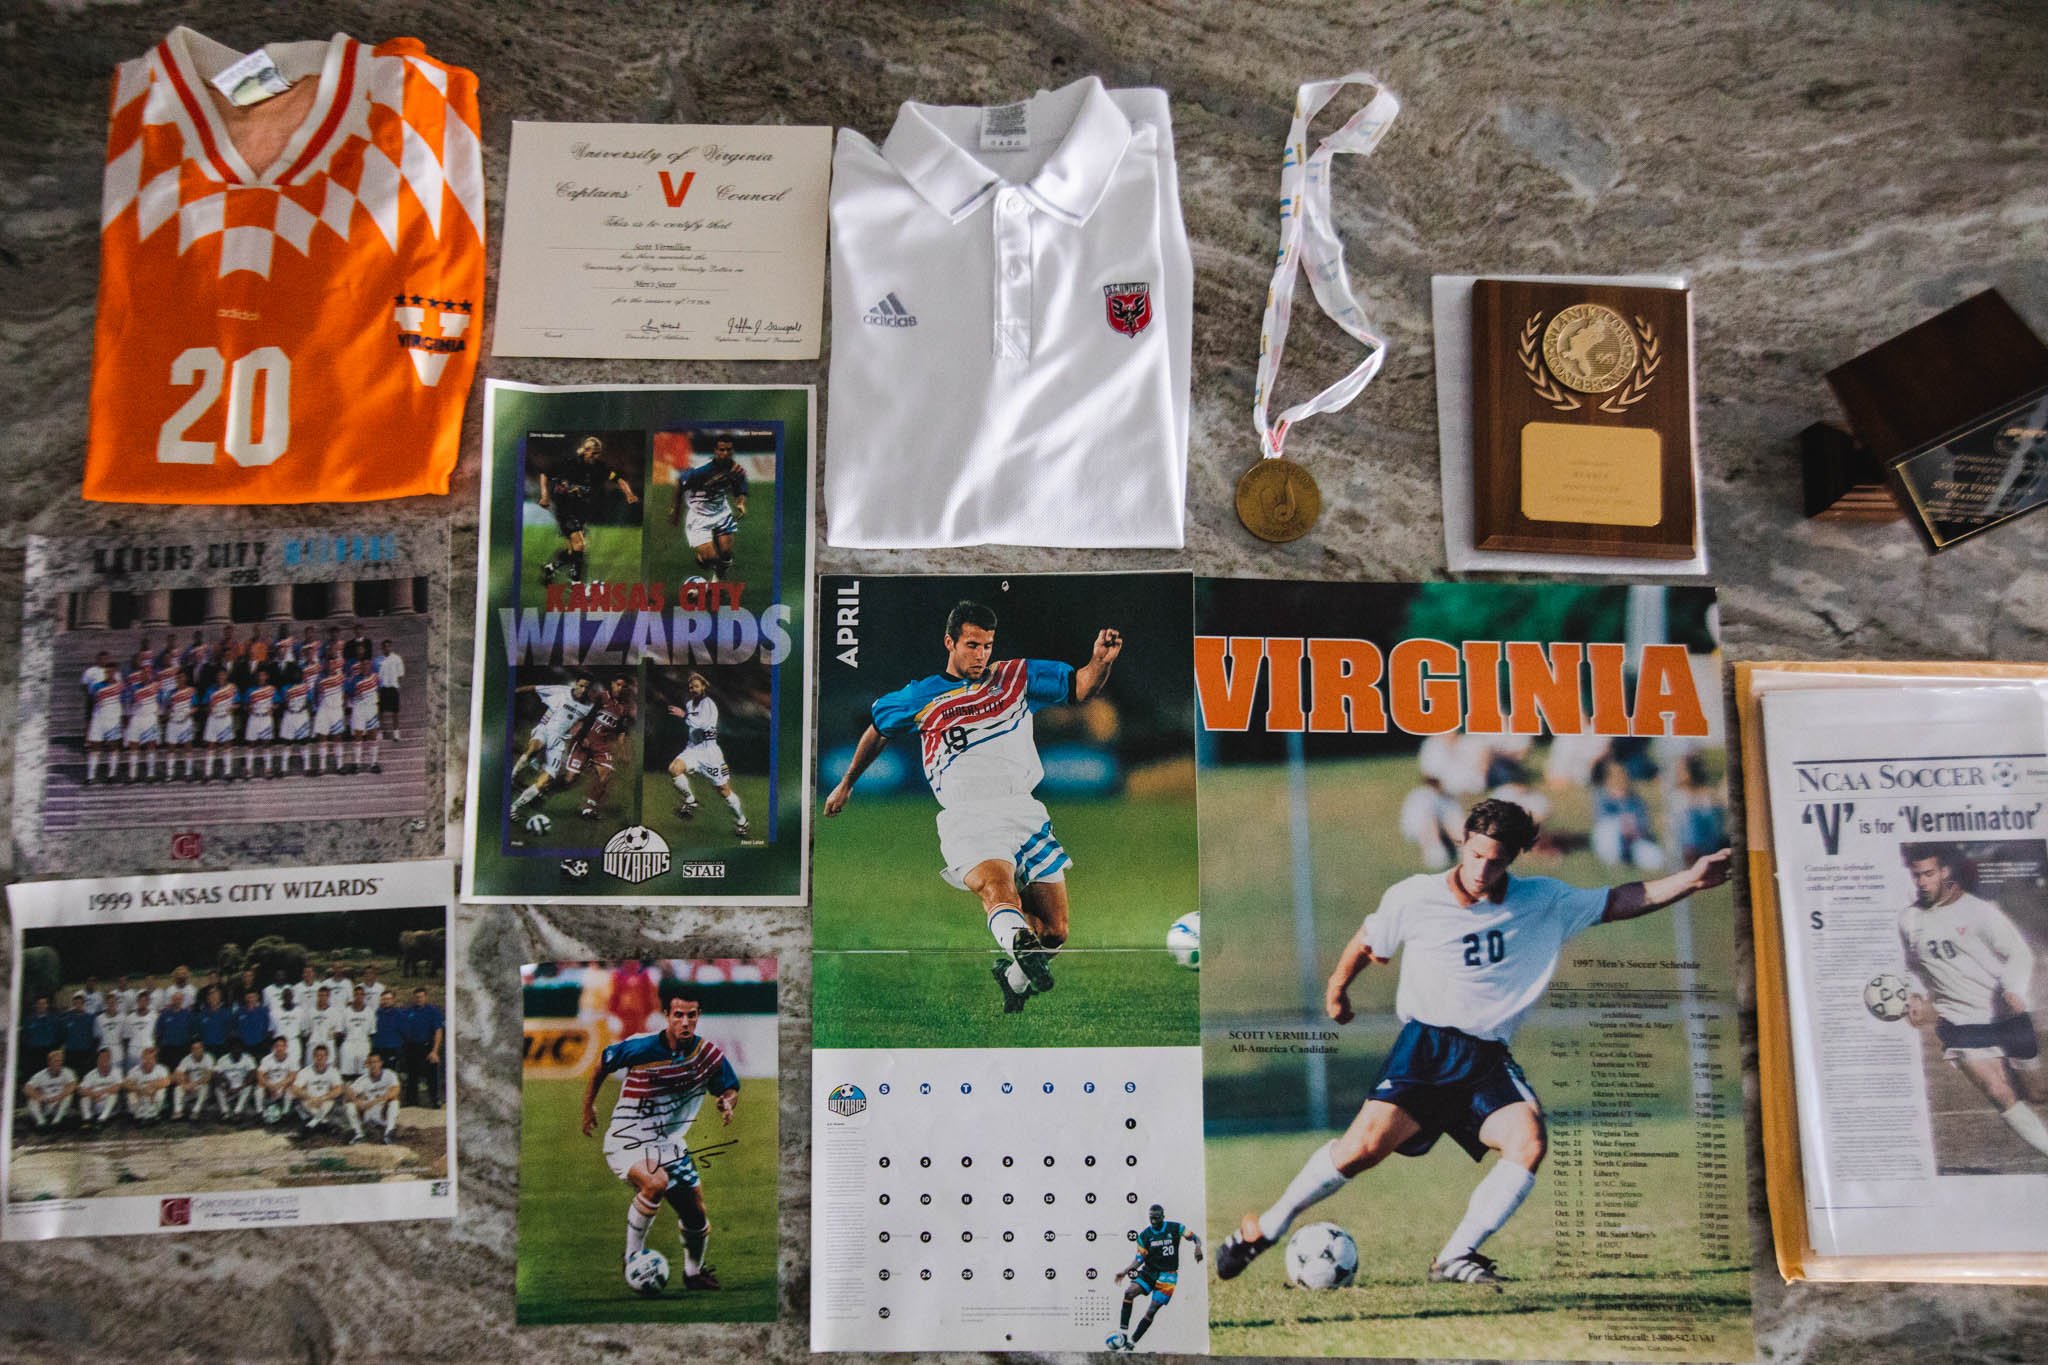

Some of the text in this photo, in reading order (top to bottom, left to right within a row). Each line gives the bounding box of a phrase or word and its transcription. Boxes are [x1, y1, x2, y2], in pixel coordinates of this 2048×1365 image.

[572, 143, 773, 166] University of Virginia
[657, 171, 696, 208] V
[716, 185, 792, 202] Council
[863, 313, 919, 328] adidas
[397, 333, 466, 353] VIRGINIA
[157, 346, 292, 468] 20
[208, 542, 266, 568] CITY
[546, 581, 746, 613] KANSAS CITY
[498, 603, 792, 666] WIZARDS
[836, 581, 860, 669] APRIL
[1194, 636, 1709, 738] VIRGINIA
[941, 725, 969, 754] 19
[1797, 764, 1985, 792] NCAA SOCCER
[1859, 820, 1872, 834] is
[1875, 818, 1895, 834] for
[603, 852, 671, 884] WIZARDS
[684, 865, 724, 877] STAR
[88, 892, 132, 911] 1999
[140, 886, 222, 908] KANSAS
[228, 883, 275, 902] CITY
[1810, 910, 1824, 930] S
[1462, 930, 1505, 966] 20
[1572, 959, 1701, 970] 1997 Men's Soccer Schedule
[1229, 1030, 1339, 1041] SCOTT VERMILLION
[1231, 1044, 1339, 1054] All-America Candidate
[829, 1098, 867, 1117] WIZARDS
[1593, 1170, 1619, 1178] Liberty
[1162, 1245, 1175, 1256] 20
